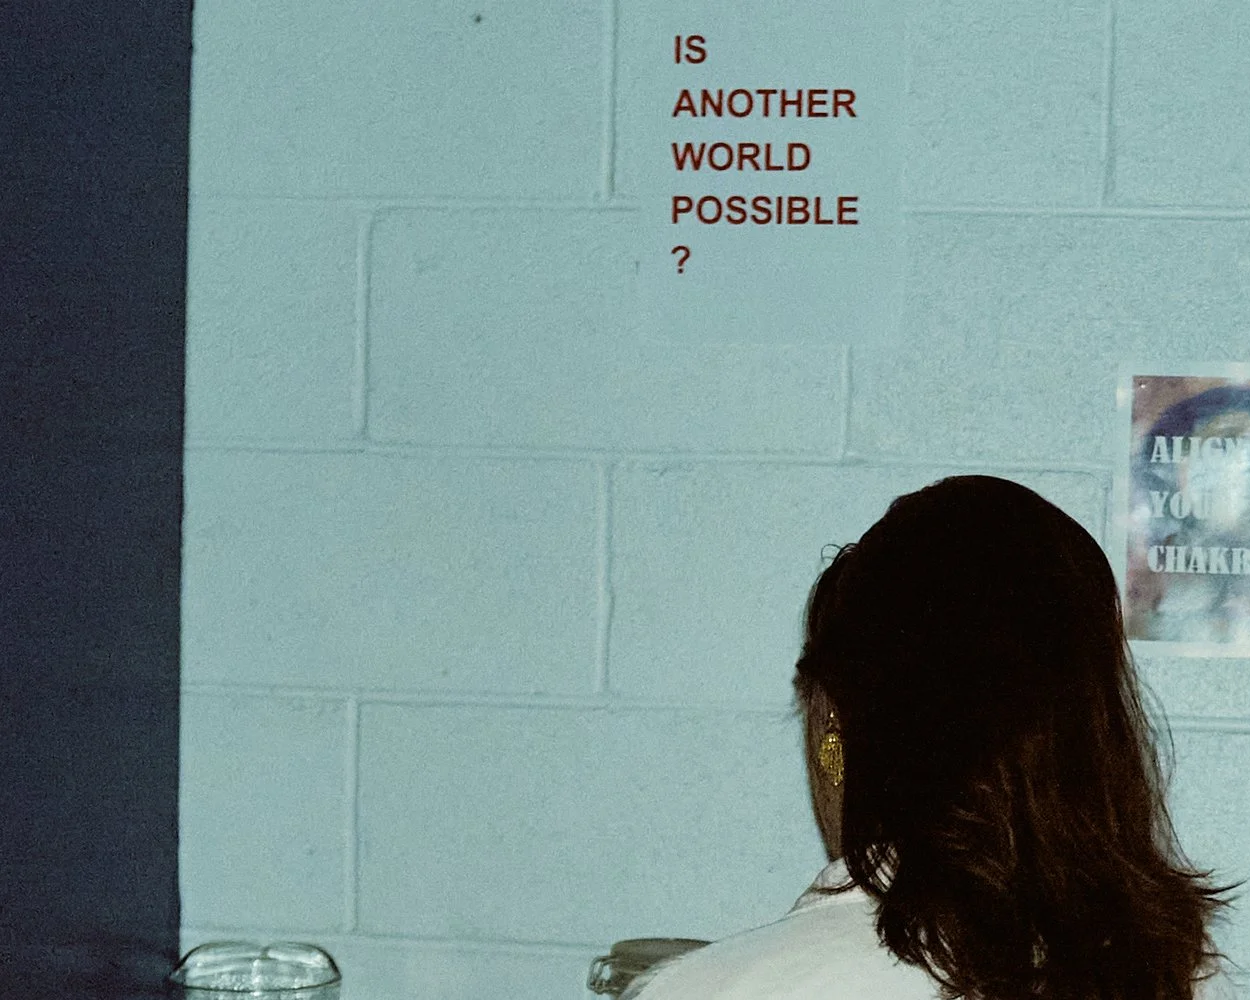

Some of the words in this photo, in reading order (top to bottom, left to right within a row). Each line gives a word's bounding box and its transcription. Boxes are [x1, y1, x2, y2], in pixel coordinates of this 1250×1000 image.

[674, 34, 708, 64] IS
[671, 88, 858, 118] ANOTHER
[671, 141, 811, 171] WORLD
[671, 195, 860, 225] POSSIBLE
[670, 244, 691, 274] ?
